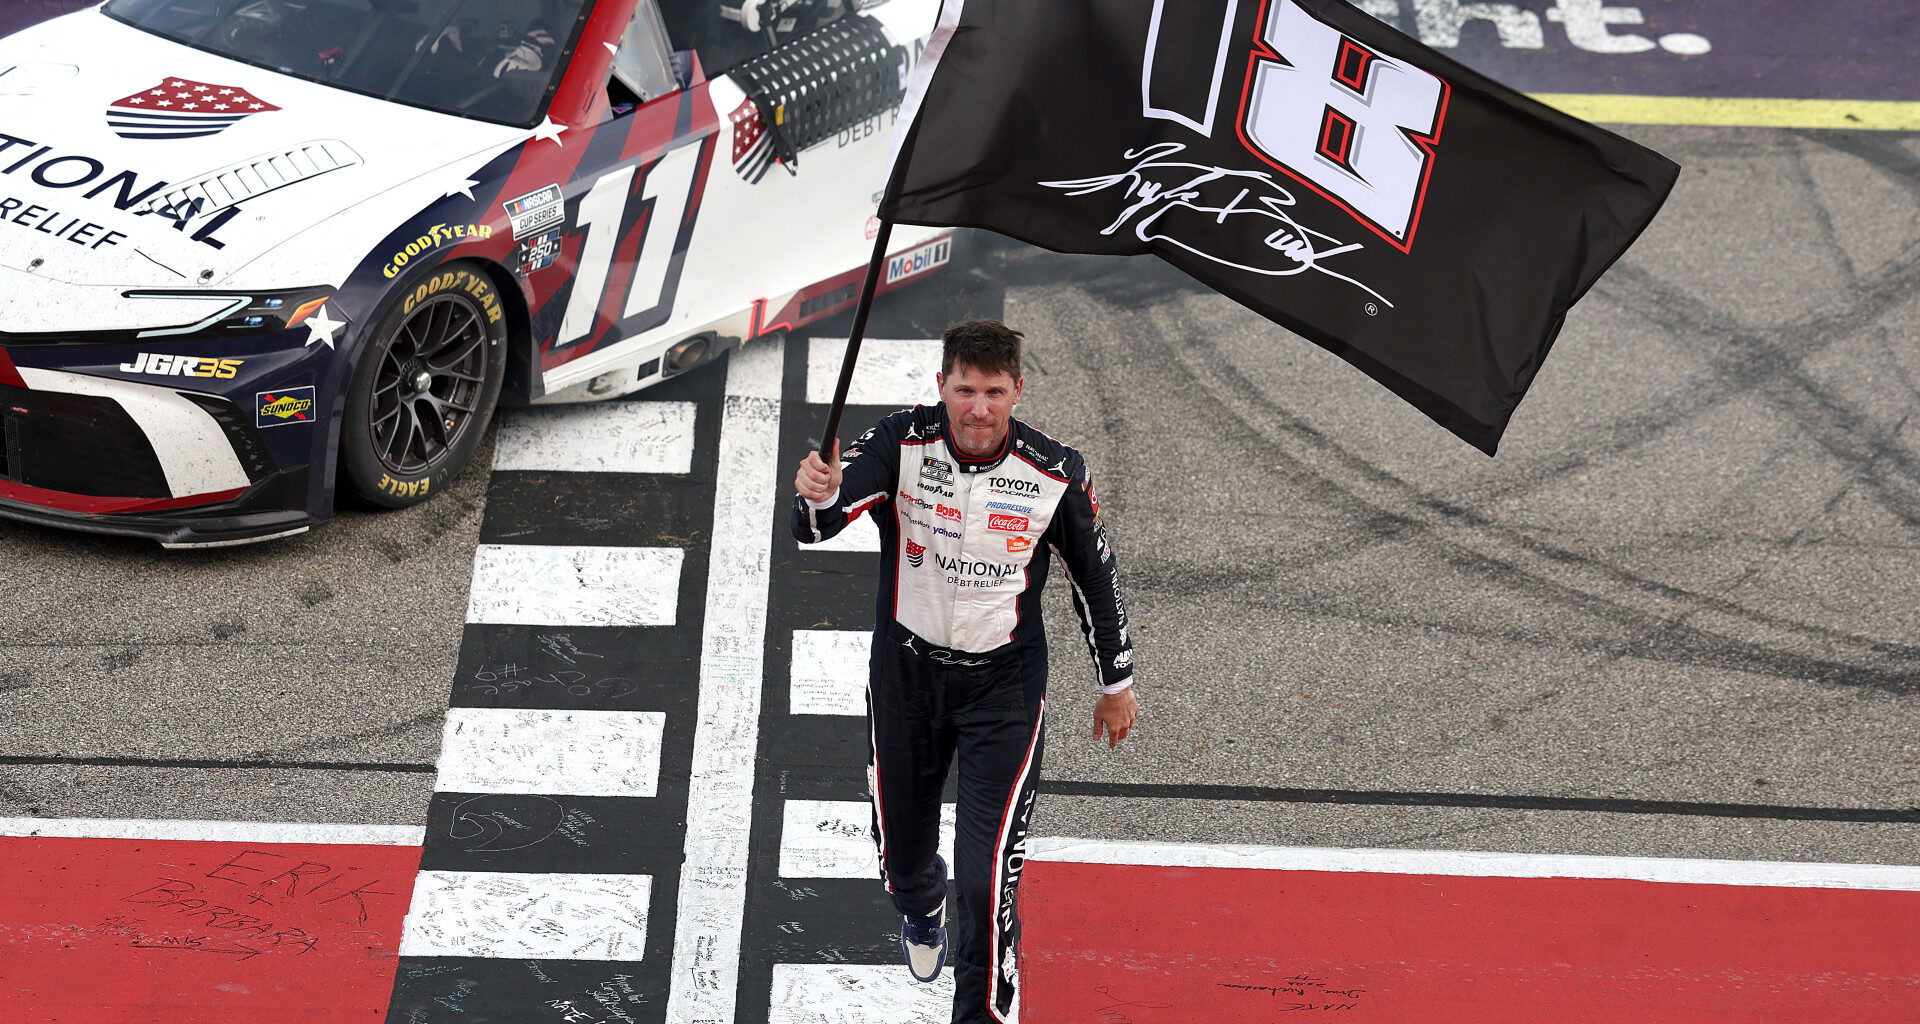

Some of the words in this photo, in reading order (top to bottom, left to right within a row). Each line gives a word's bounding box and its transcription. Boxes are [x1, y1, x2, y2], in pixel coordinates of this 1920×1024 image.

[838, 113, 883, 148] DEBT
[523, 189, 554, 211] NASCAR
[519, 214, 534, 229] CUP
[534, 205, 557, 224] SERIES
[383, 223, 492, 278] GOODYEAR
[528, 240, 553, 262] 250
[555, 138, 704, 349] 11
[889, 247, 931, 280] Mobil
[934, 243, 949, 264] 1
[403, 271, 502, 324] GOODYEAR
[261, 399, 311, 416] SUNOCO
[378, 473, 430, 498] EAGLE
[987, 488, 1040, 500] RACING
[989, 477, 1040, 494] TOYOTA
[936, 503, 962, 520] BOB'S
[985, 501, 1034, 514] PROGRESSIVE
[933, 526, 962, 540] yahoo!
[935, 553, 1019, 578] NATIONAL
[947, 576, 971, 588] DEBT
[973, 579, 1005, 589] RELIEF
[205, 850, 395, 926] ERIK
